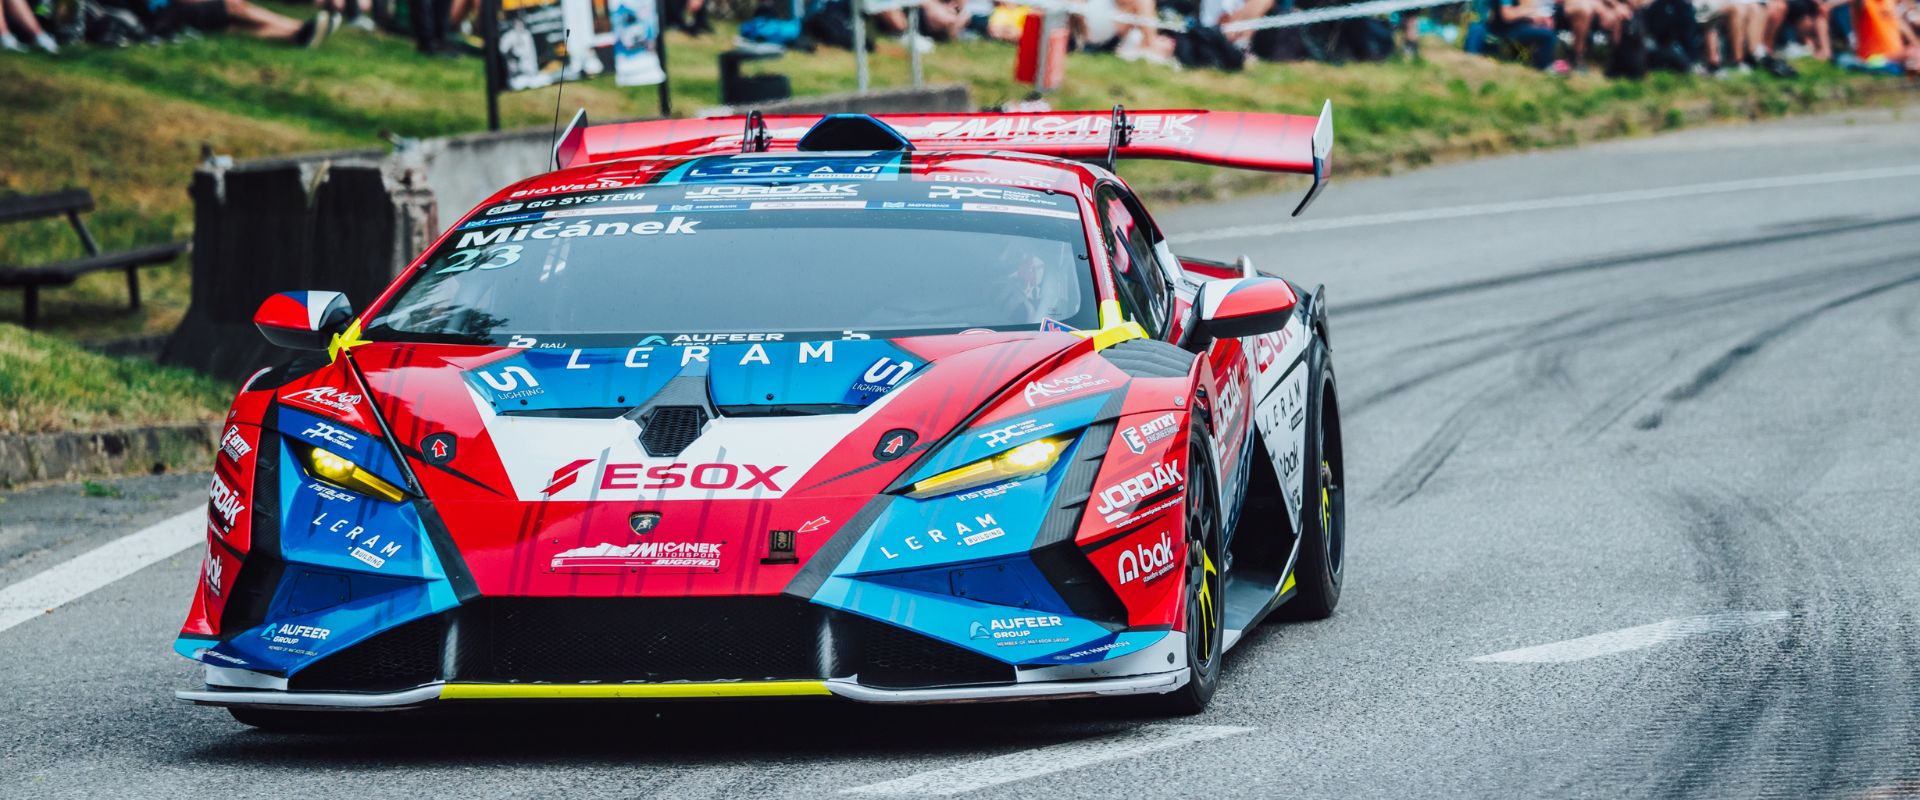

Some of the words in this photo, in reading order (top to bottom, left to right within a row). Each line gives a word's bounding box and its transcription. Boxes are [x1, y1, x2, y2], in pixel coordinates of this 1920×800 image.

[690, 166, 881, 176] LERAM
[929, 186, 1003, 199] PPC
[527, 197, 557, 209] GC
[558, 193, 646, 206] SYSTEM
[456, 217, 702, 249] Mičánek
[436, 244, 524, 275] 23
[672, 333, 784, 342] AUFEER
[566, 341, 833, 370] LERAM
[498, 388, 544, 400] LIGHTING
[852, 382, 892, 393] LIGHTING
[1140, 412, 1176, 437] ENTRY
[600, 463, 790, 491] ESOX
[312, 512, 402, 558] LERAM
[880, 513, 997, 560] LERAM
[655, 558, 717, 566] BUGGYRA
[991, 615, 1063, 630] AUFEER
[278, 623, 331, 640] AUFEER
[993, 630, 1031, 639] GROUP
[272, 635, 300, 645] GROUP
